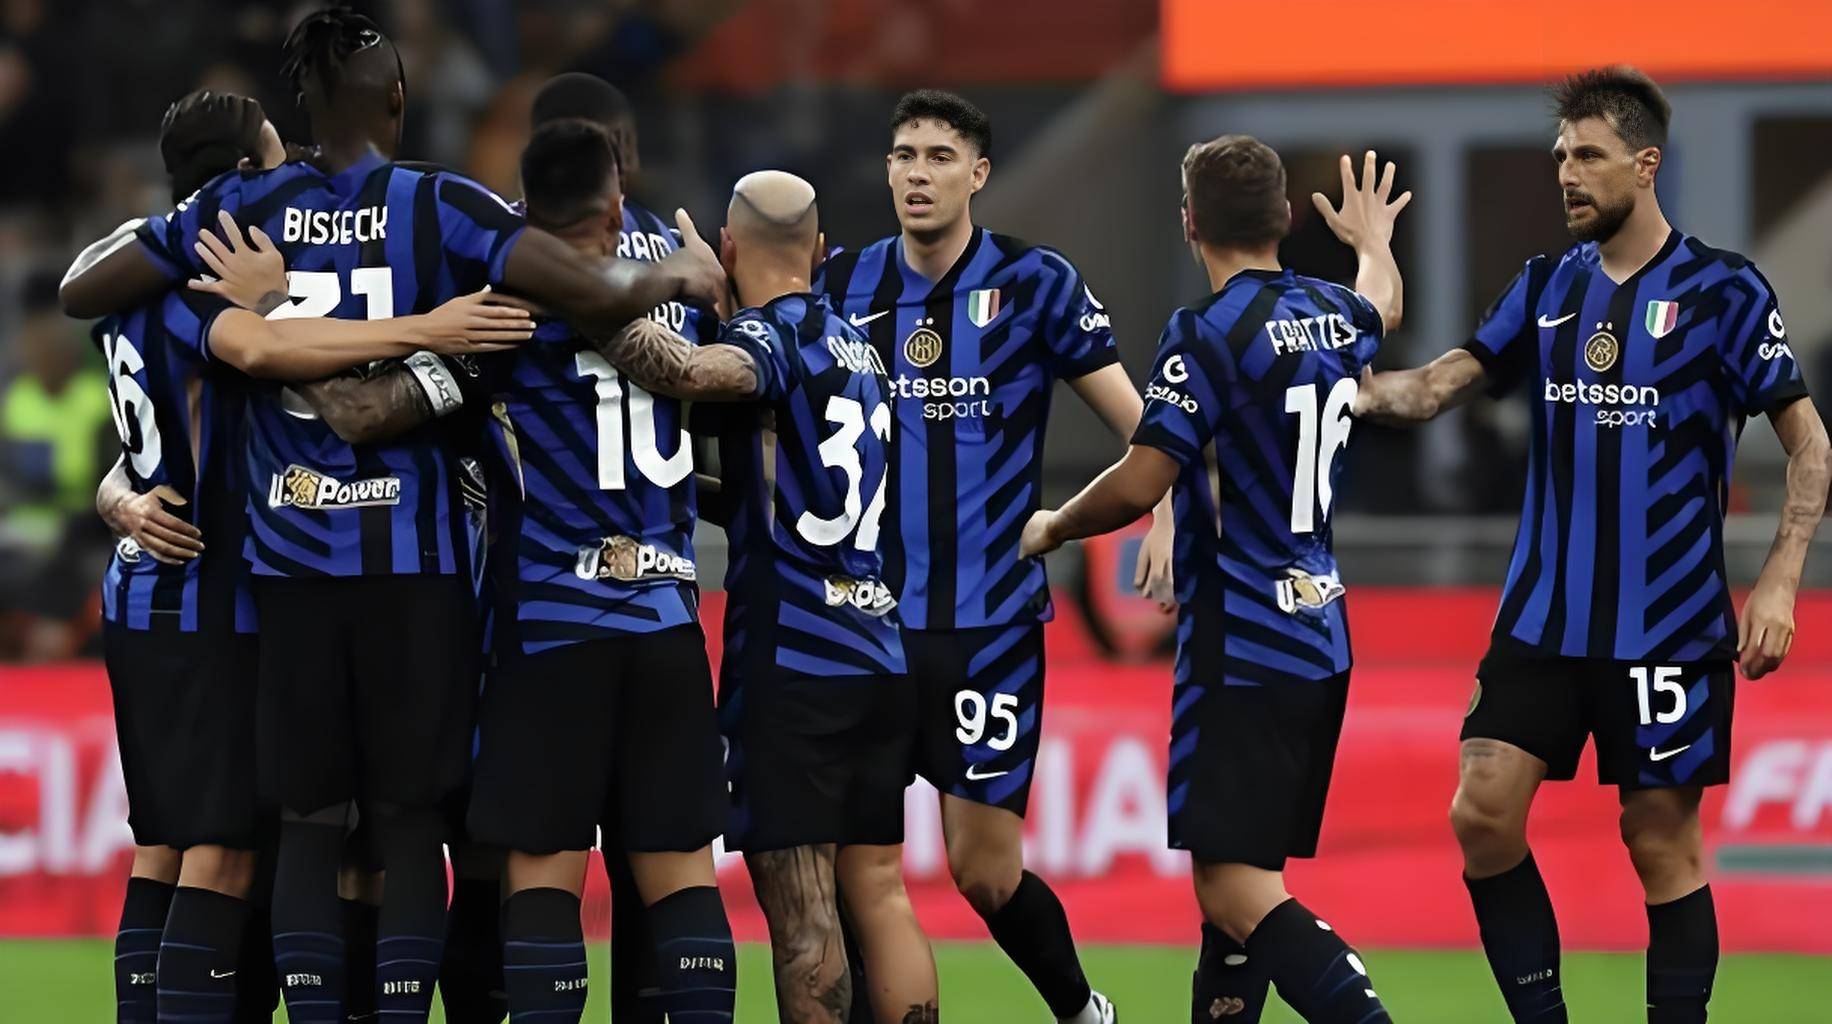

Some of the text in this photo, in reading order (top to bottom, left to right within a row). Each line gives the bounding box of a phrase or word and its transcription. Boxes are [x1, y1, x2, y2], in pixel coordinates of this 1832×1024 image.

[283, 206, 388, 245] BISSECK
[1544, 377, 1659, 406] betsson
[1285, 377, 1358, 533] 16
[954, 689, 1018, 751] 95
[1629, 666, 1688, 725] 15
